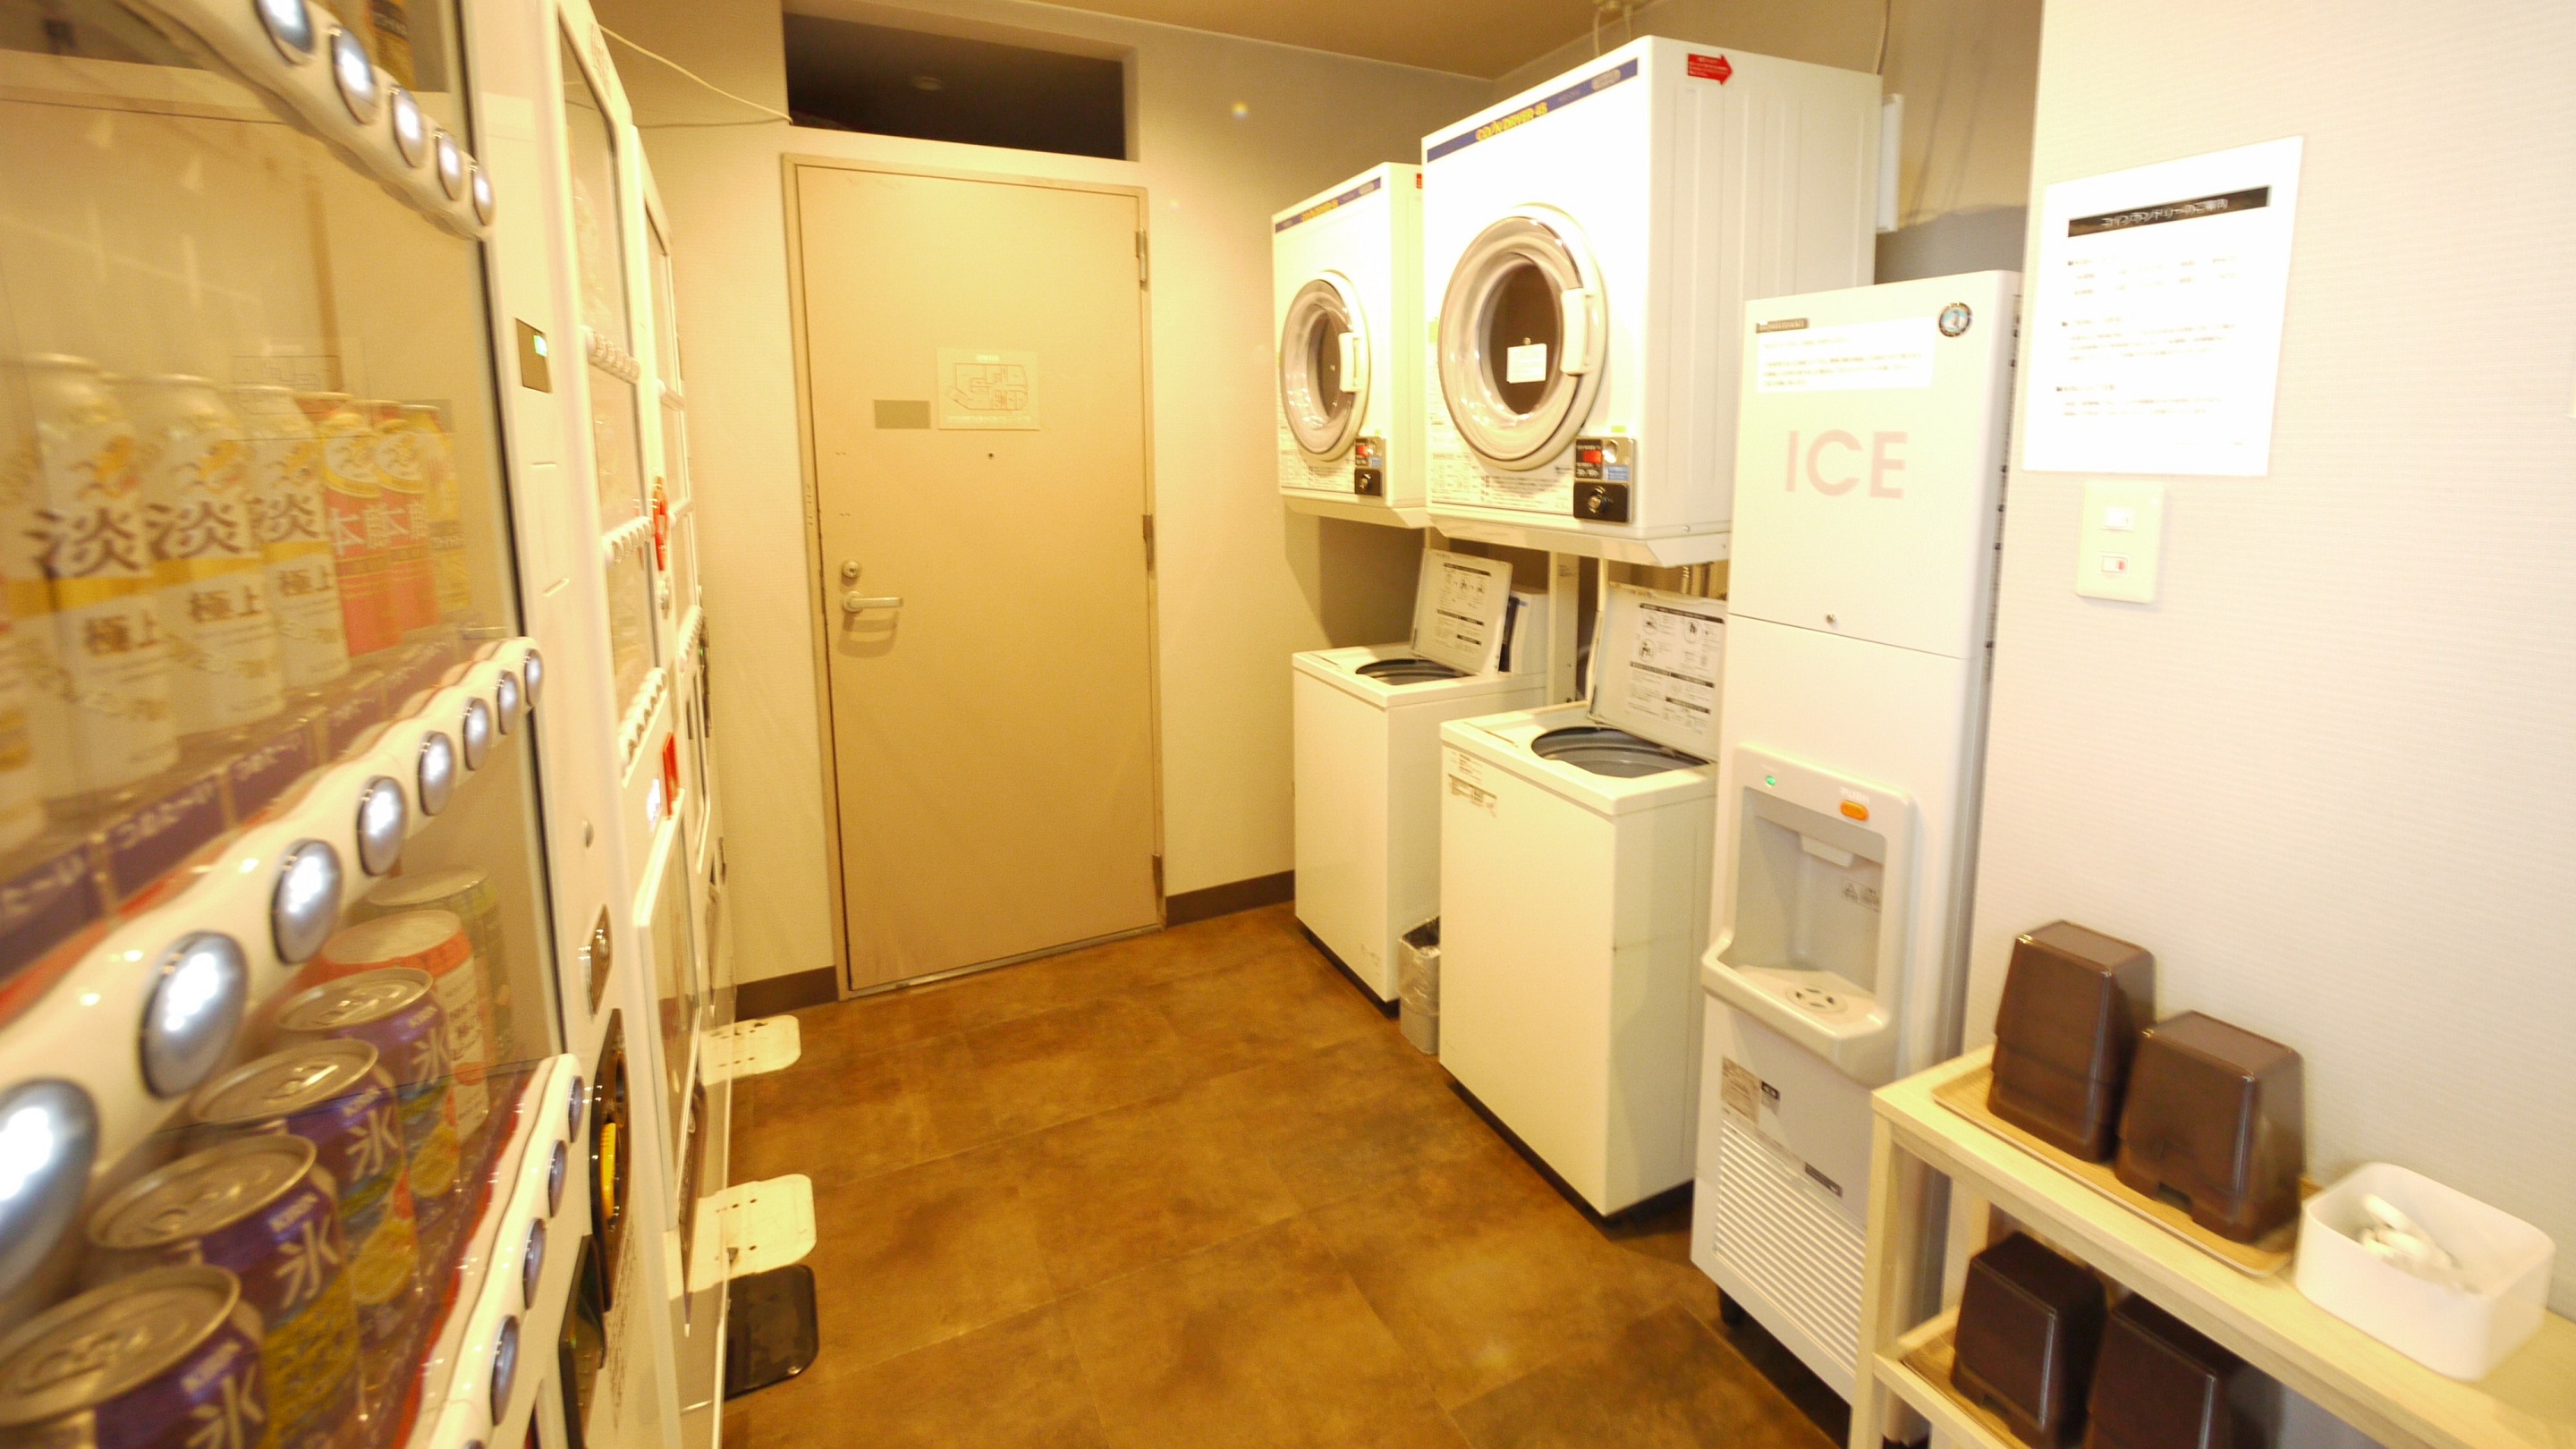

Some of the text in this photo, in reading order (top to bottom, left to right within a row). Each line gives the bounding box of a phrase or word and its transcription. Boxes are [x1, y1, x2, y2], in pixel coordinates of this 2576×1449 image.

[1785, 429, 1909, 499] ICE
[344, 1106, 400, 1182] 氷
[274, 1214, 342, 1309] 氷
